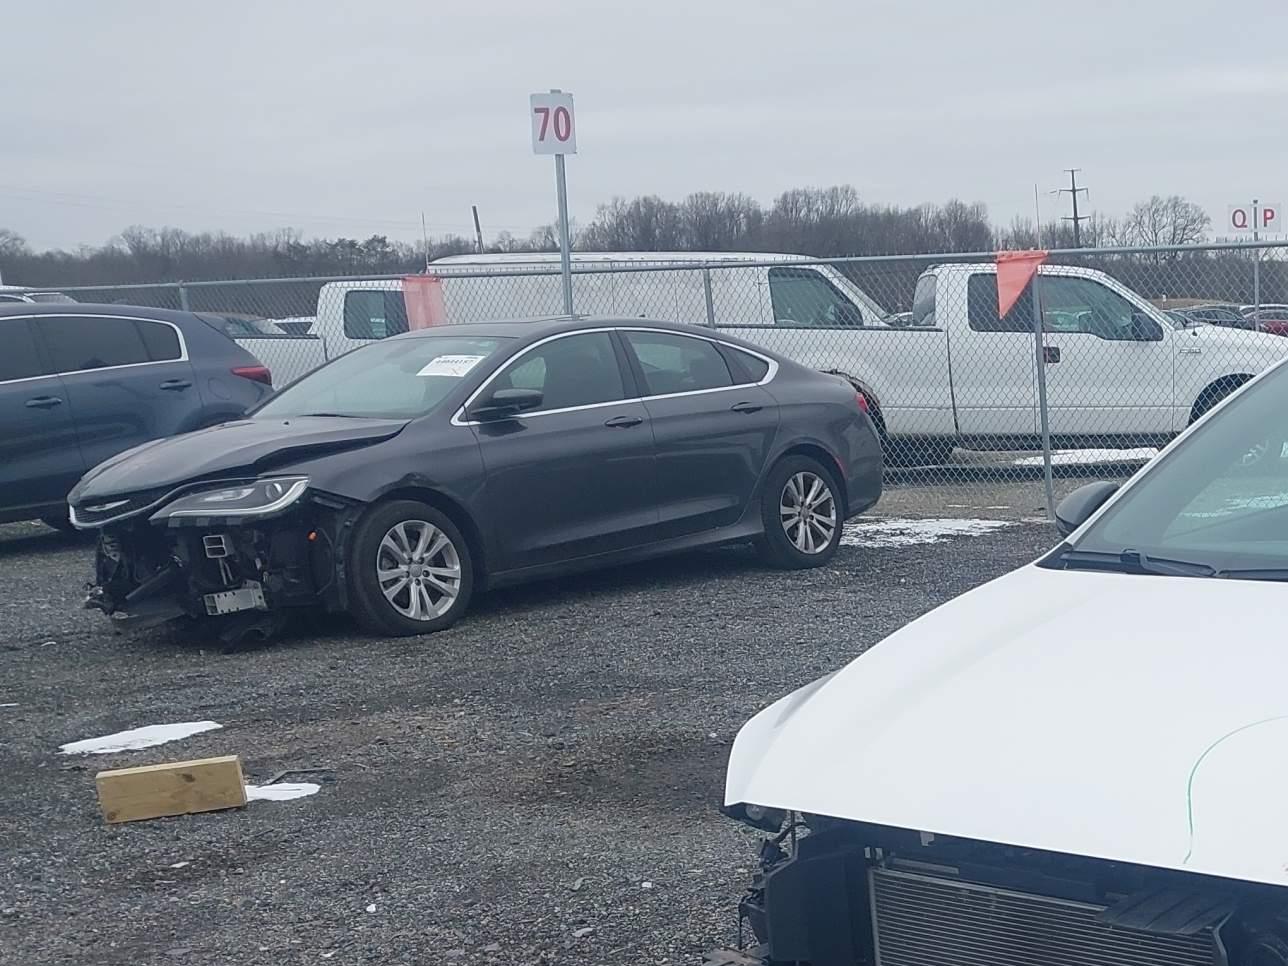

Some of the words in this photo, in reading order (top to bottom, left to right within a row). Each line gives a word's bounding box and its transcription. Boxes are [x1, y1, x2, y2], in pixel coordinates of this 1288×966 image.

[534, 106, 571, 142] 70
[1232, 208, 1248, 229] Q
[1263, 208, 1275, 228] P
